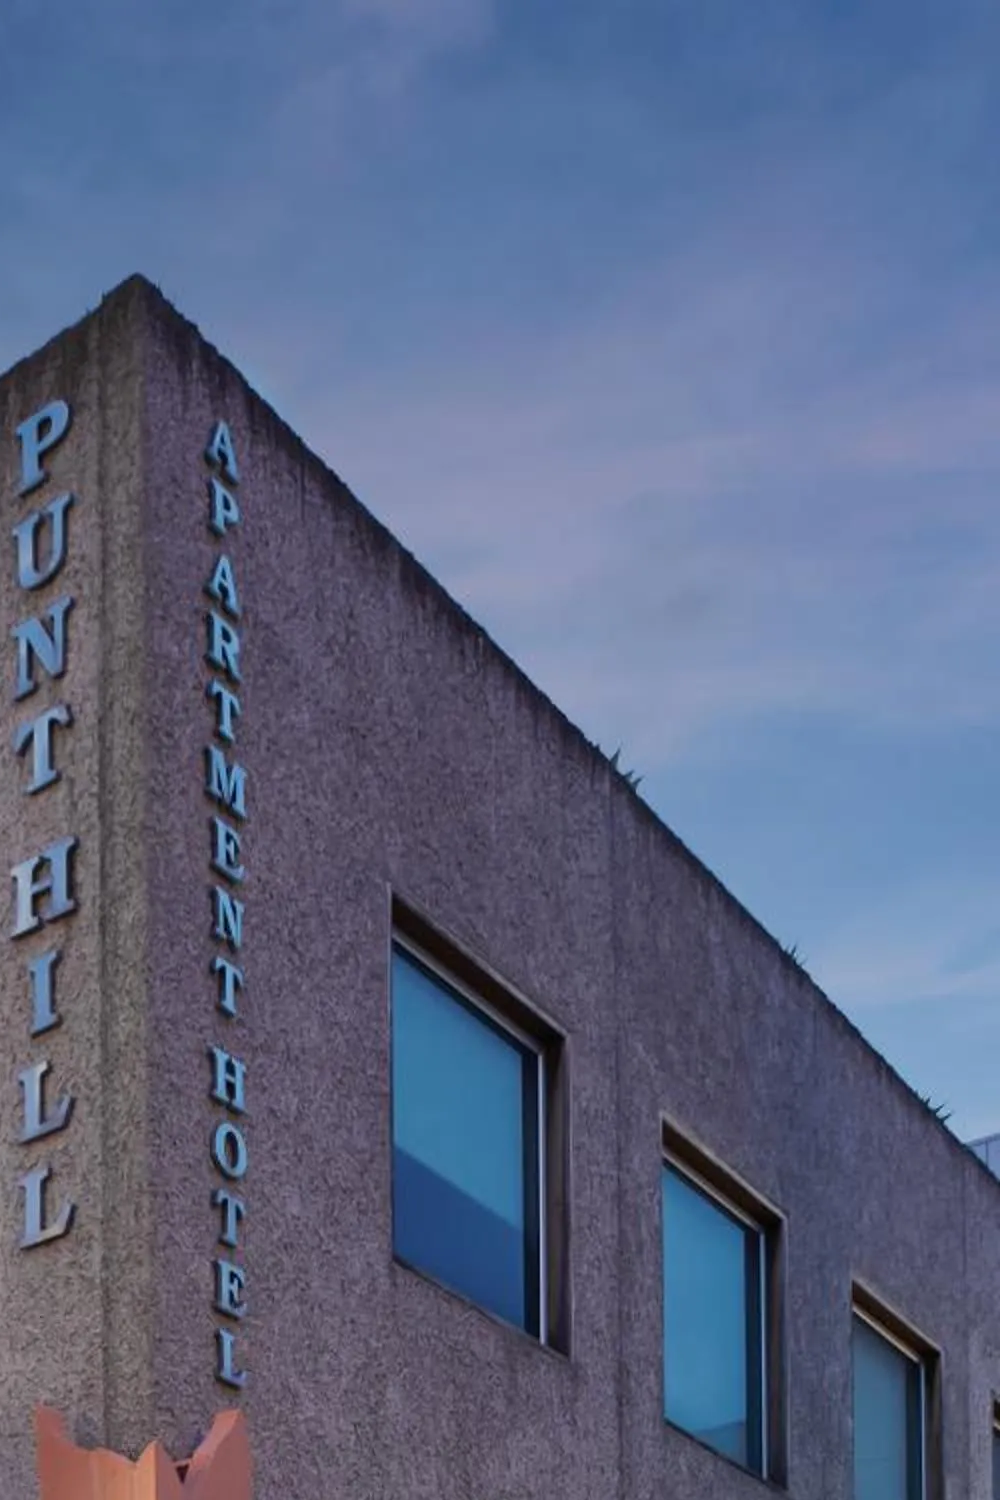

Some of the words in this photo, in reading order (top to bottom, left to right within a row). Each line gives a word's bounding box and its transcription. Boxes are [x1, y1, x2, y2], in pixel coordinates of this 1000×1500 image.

[10, 398, 76, 797] PUNT
[204, 420, 249, 1017] APARTMENT
[9, 835, 78, 1251] HILL
[209, 1045, 248, 1388] HOTEL
